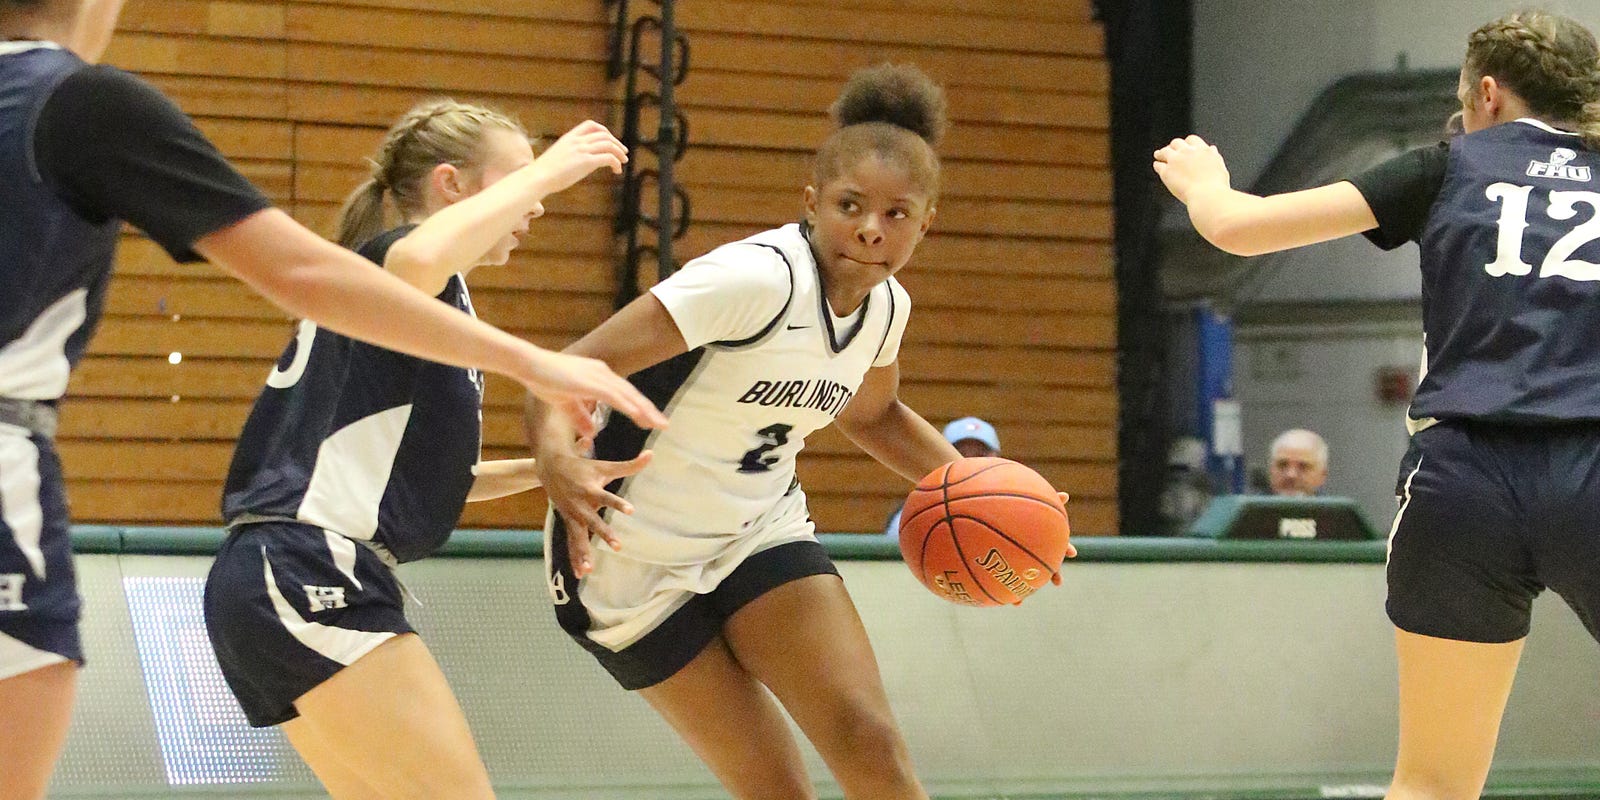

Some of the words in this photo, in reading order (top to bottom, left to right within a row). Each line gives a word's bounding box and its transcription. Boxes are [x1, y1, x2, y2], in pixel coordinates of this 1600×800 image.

[1527, 160, 1591, 181] FHU
[1484, 182, 1600, 281] 12
[736, 423, 794, 473] 2
